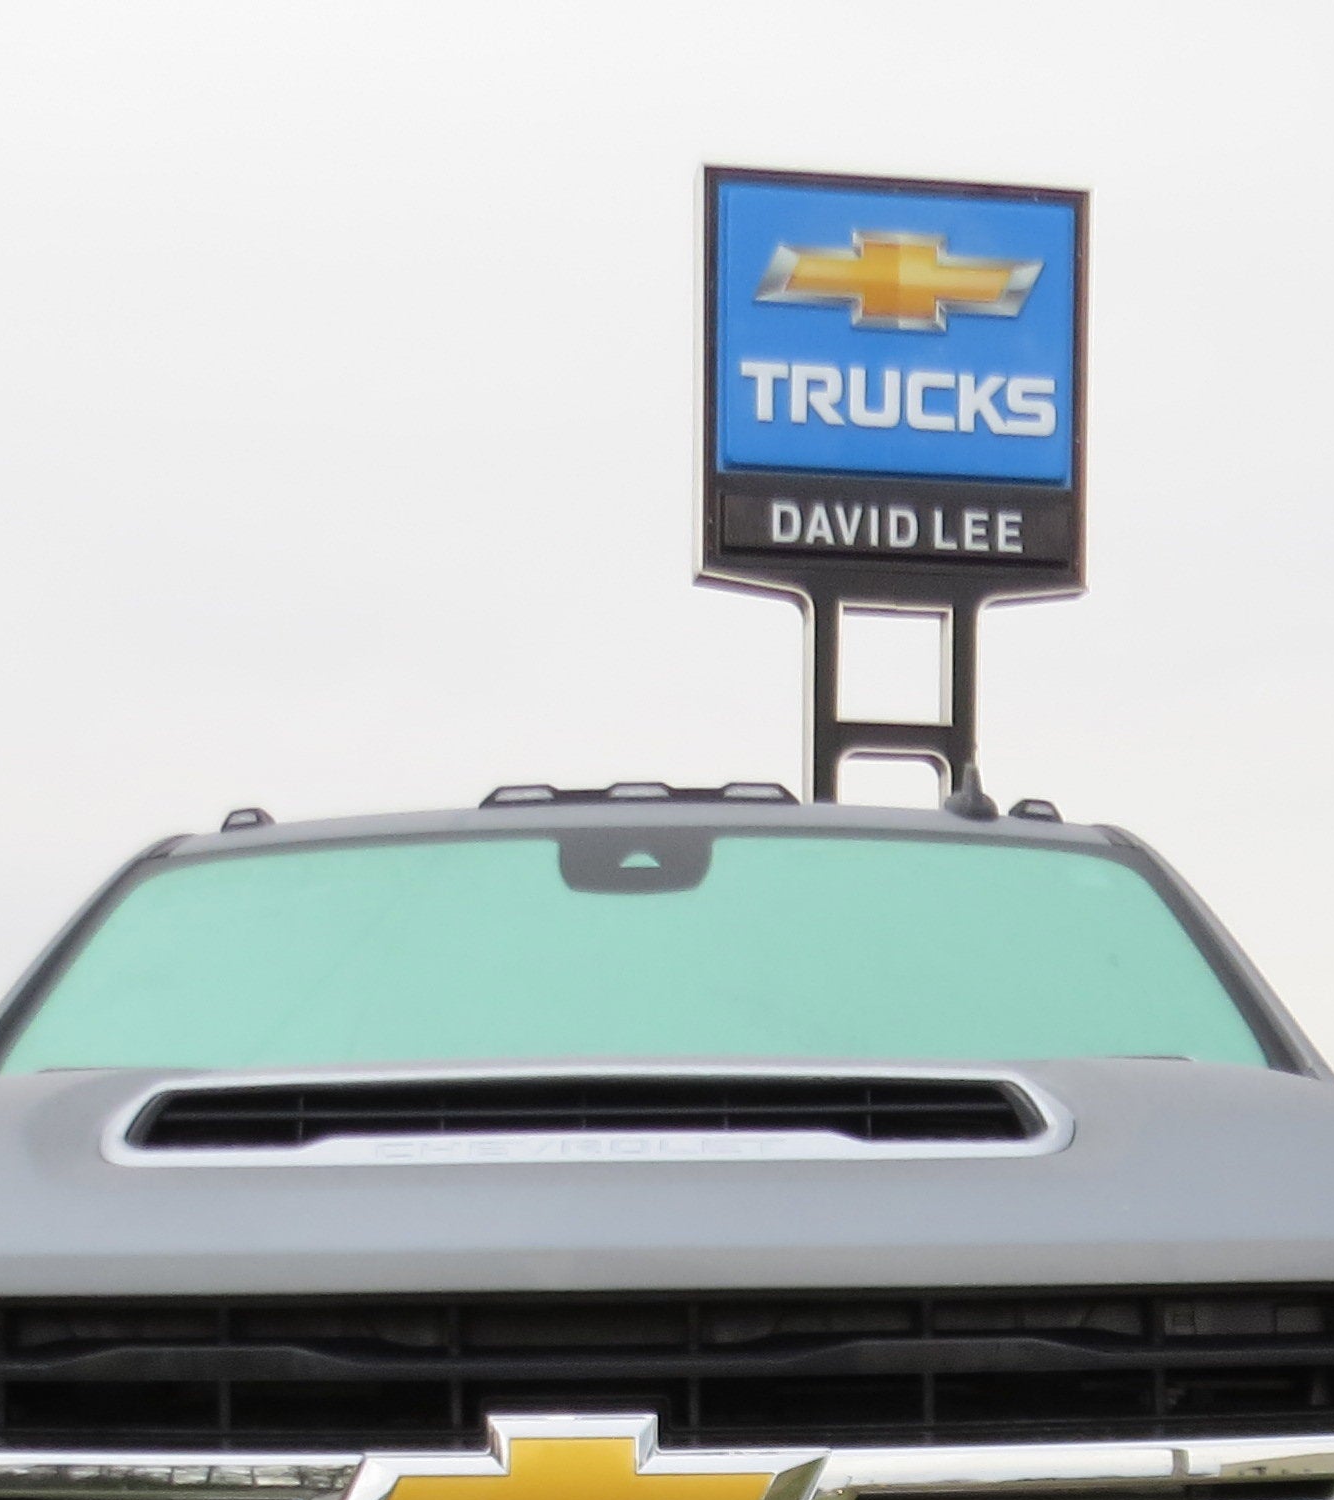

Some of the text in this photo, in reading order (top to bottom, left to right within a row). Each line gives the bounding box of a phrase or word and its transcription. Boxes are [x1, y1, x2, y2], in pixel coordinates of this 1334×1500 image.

[741, 360, 1057, 437] TRUCKS
[771, 500, 1024, 554] DAVID LEE
